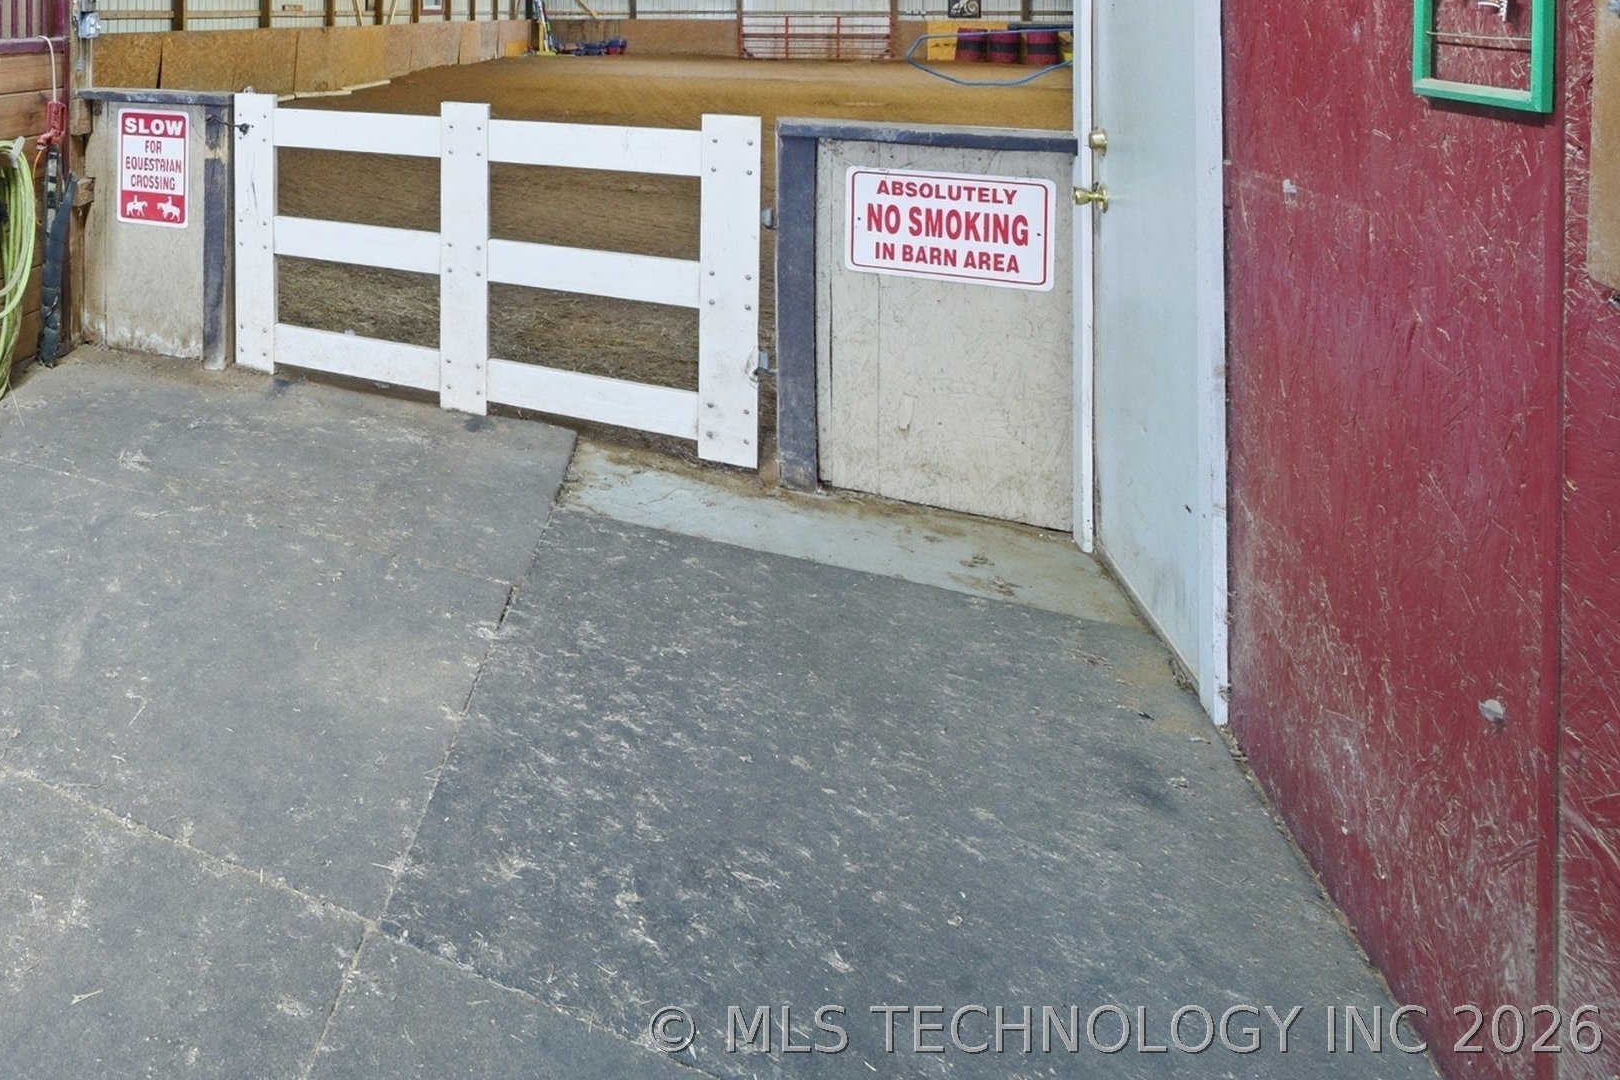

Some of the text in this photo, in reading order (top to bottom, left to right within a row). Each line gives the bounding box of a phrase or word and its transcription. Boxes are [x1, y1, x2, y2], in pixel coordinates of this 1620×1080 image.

[124, 117, 184, 136] SLOW
[145, 140, 162, 154] FOR
[125, 156, 182, 173] EQUESTRIAN
[131, 174, 176, 191] CROSSING
[876, 179, 1017, 205] ABSOLUTELY
[867, 203, 1029, 246] NO SMOKING
[875, 241, 1020, 273] IN BARN AREA
